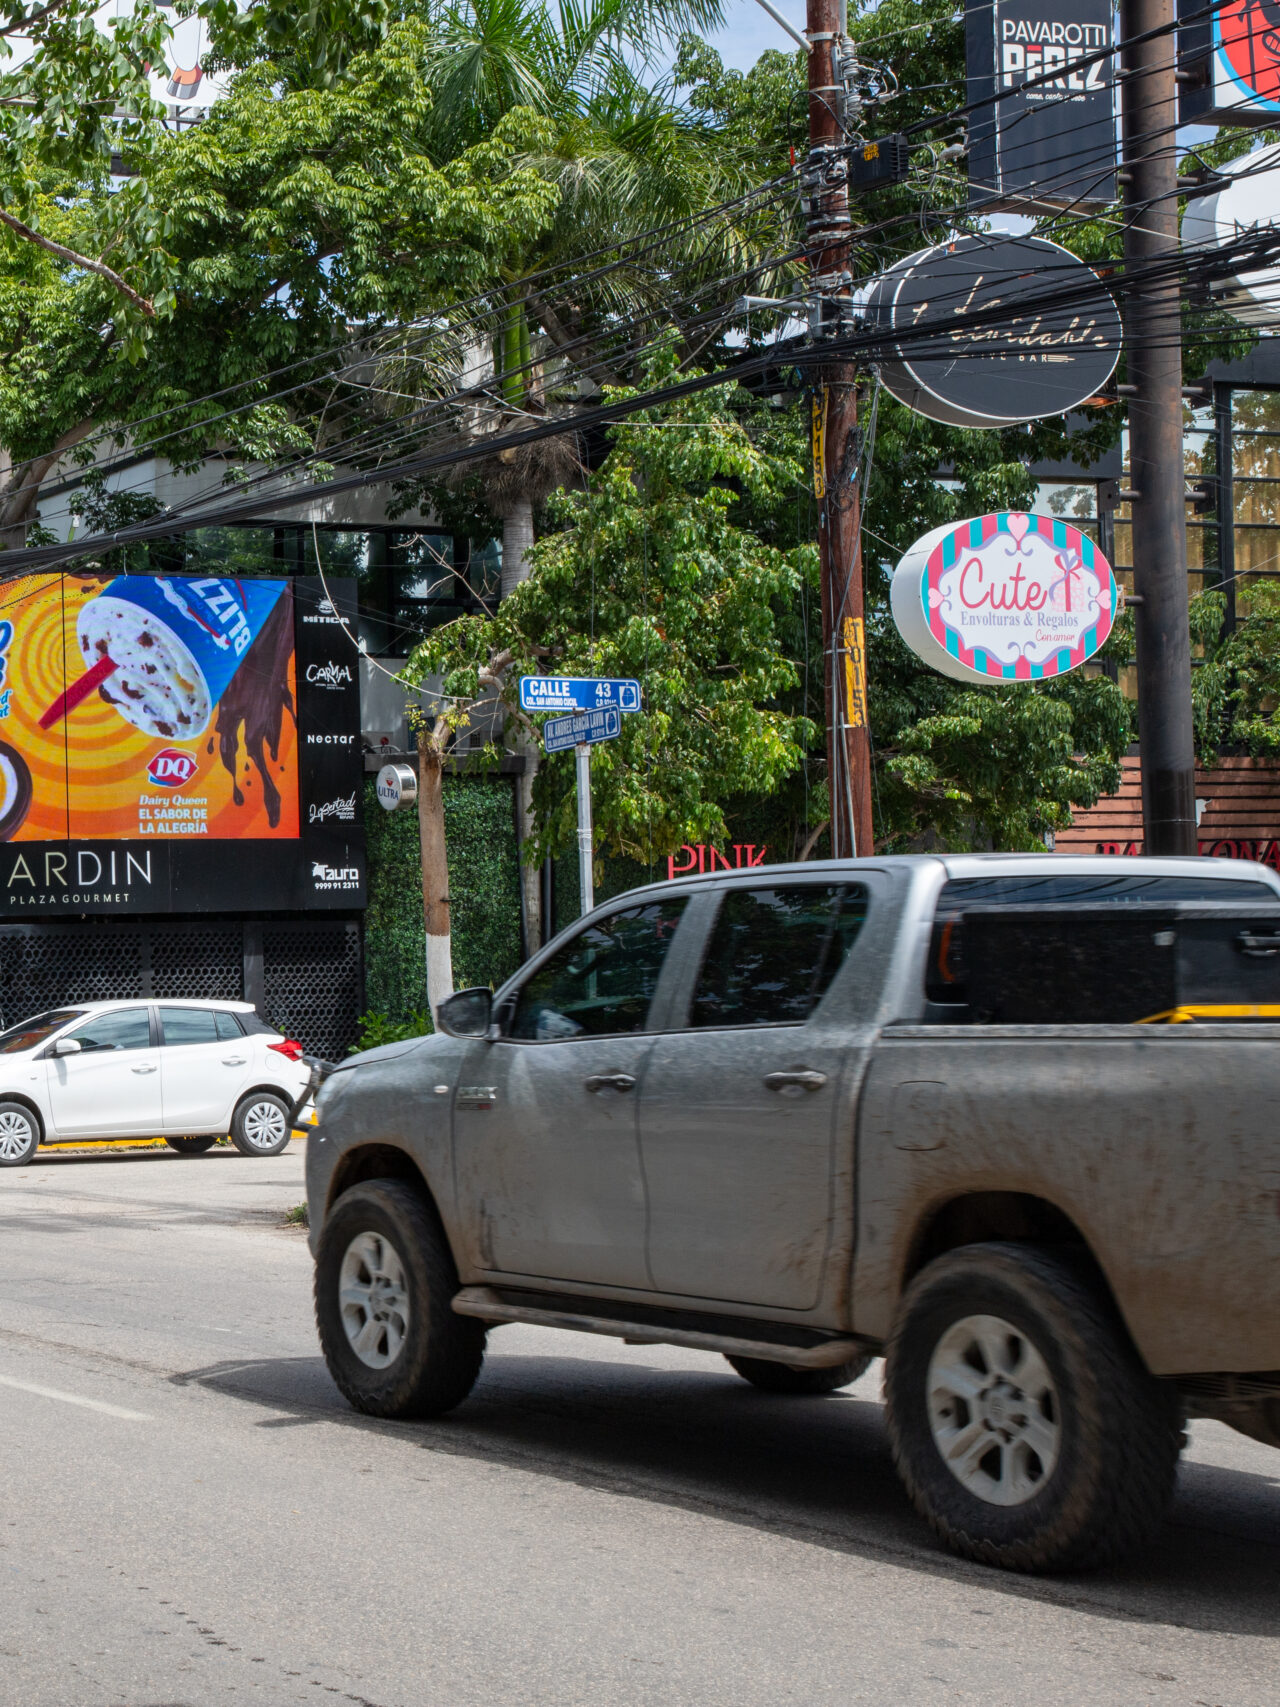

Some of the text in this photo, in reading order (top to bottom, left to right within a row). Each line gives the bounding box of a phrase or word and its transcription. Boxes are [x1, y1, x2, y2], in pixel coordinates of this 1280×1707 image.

[1002, 19, 1107, 46] PAVAROTTI
[959, 557, 1048, 611] Cute
[960, 611, 1079, 630] Envolturas & Regalos
[529, 680, 611, 698] CALLE 43
[156, 757, 189, 780] DQ
[139, 793, 208, 807] Dairy Queen
[378, 785, 399, 801] ULTRA
[138, 807, 208, 820] EL SABOR DE
[138, 819, 209, 834] LA ALEGRÍA
[317, 864, 359, 880] Tauro
[315, 881, 360, 890] 9999 91 2311
[10, 893, 131, 905] PLAZA GOURMET
